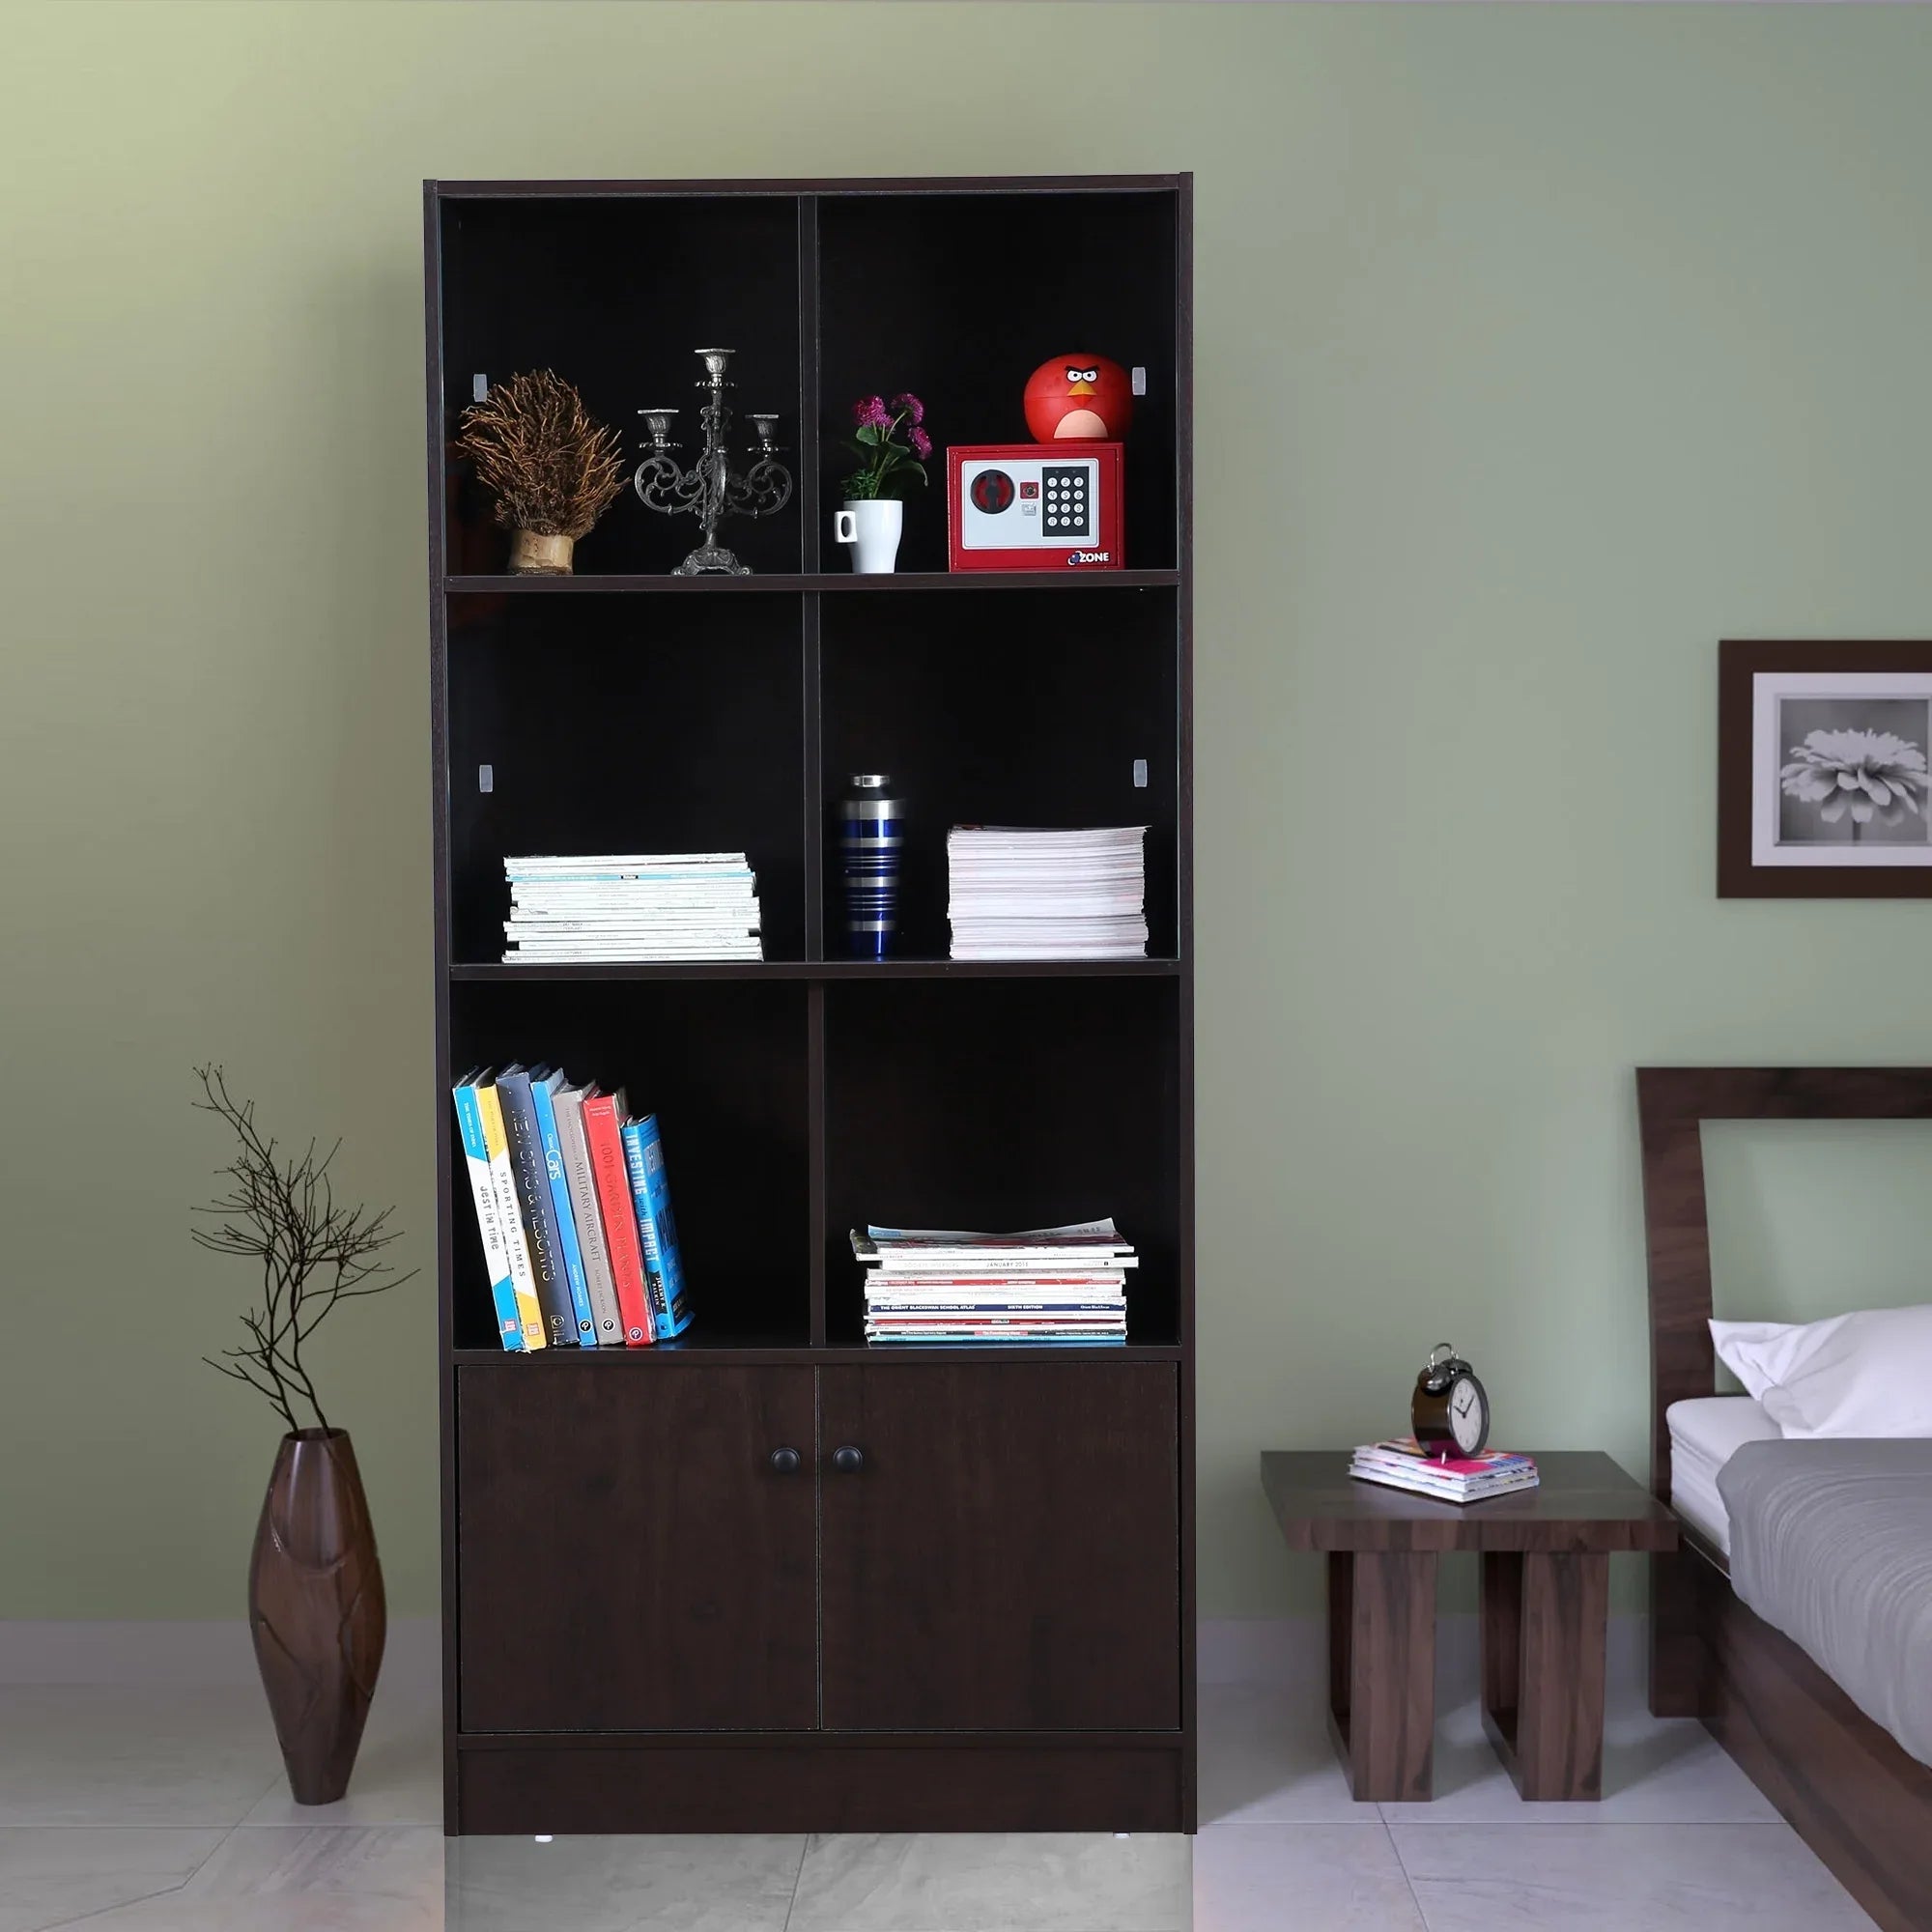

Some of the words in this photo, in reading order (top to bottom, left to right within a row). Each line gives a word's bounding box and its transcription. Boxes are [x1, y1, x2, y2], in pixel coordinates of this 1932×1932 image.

[511, 1108, 531, 1145] NEW
[520, 1151, 539, 1189] SPAS
[546, 1149, 562, 1179] Cars
[625, 1134, 647, 1195] INVESTING
[527, 1194, 542, 1205] &
[575, 1162, 592, 1209] MILITARY
[584, 1211, 601, 1261] AIRCRAFT
[638, 1198, 648, 1216] with
[500, 1172, 518, 1234] SPORTING
[513, 1240, 526, 1277] TIMES
[639, 1218, 660, 1262] IMPACT
[530, 1208, 556, 1281] RESORTS
[656, 1277, 665, 1300] JEREMY
